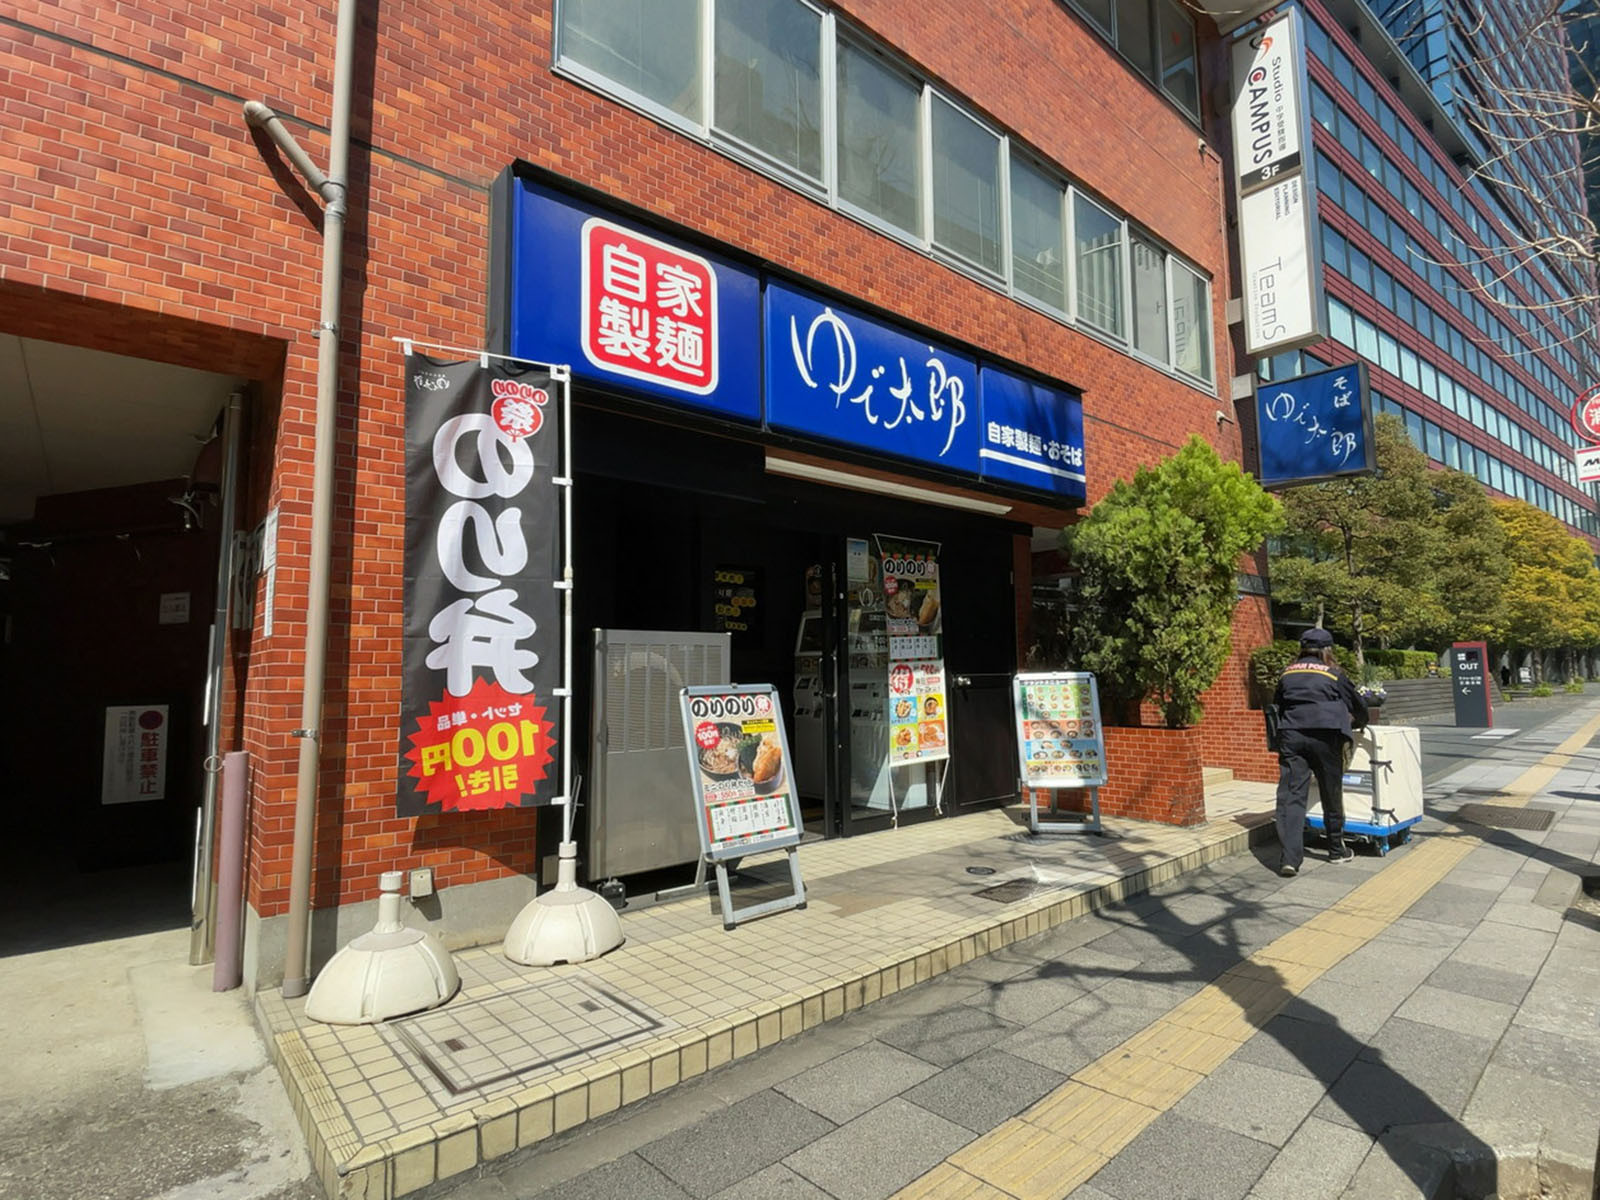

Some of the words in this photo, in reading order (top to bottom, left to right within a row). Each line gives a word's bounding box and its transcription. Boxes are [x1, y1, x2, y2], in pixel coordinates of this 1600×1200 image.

[1272, 56, 1284, 103] Studio
[1248, 66, 1273, 164] CAMPUS
[1261, 165, 1280, 180] 3F
[602, 243, 703, 318] 自家
[598, 295, 705, 378] 製麺
[790, 306, 967, 457] ゆで太郎
[1333, 376, 1353, 408] そば
[987, 421, 1083, 468] 自家製麺・おそば
[1265, 392, 1357, 466] ゆで太郎
[1459, 662, 1478, 670] OUT
[691, 697, 755, 718] のりのり
